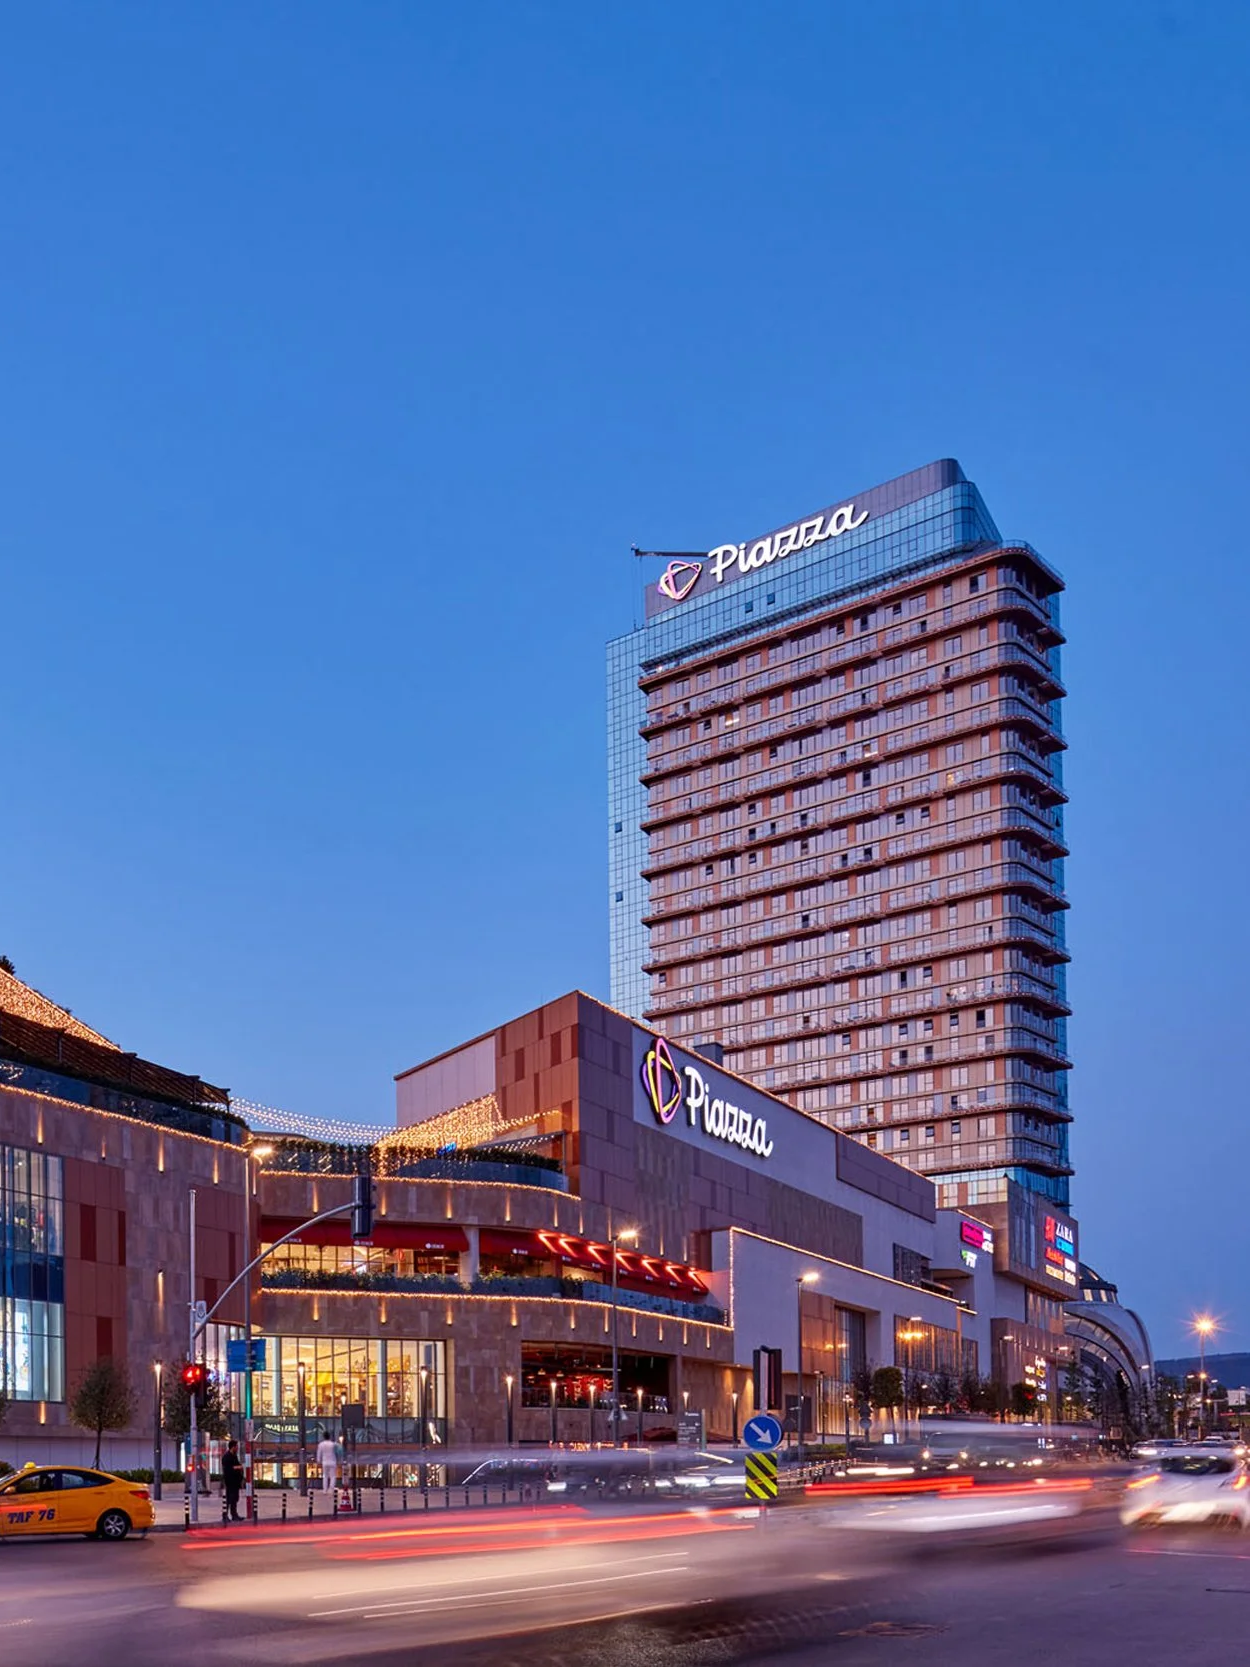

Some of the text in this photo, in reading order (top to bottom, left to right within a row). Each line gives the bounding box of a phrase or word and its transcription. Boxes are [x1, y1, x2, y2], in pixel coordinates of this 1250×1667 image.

[707, 503, 869, 583] Piazza
[683, 1066, 774, 1158] Piazza
[1055, 1222, 1074, 1244] ZARA
